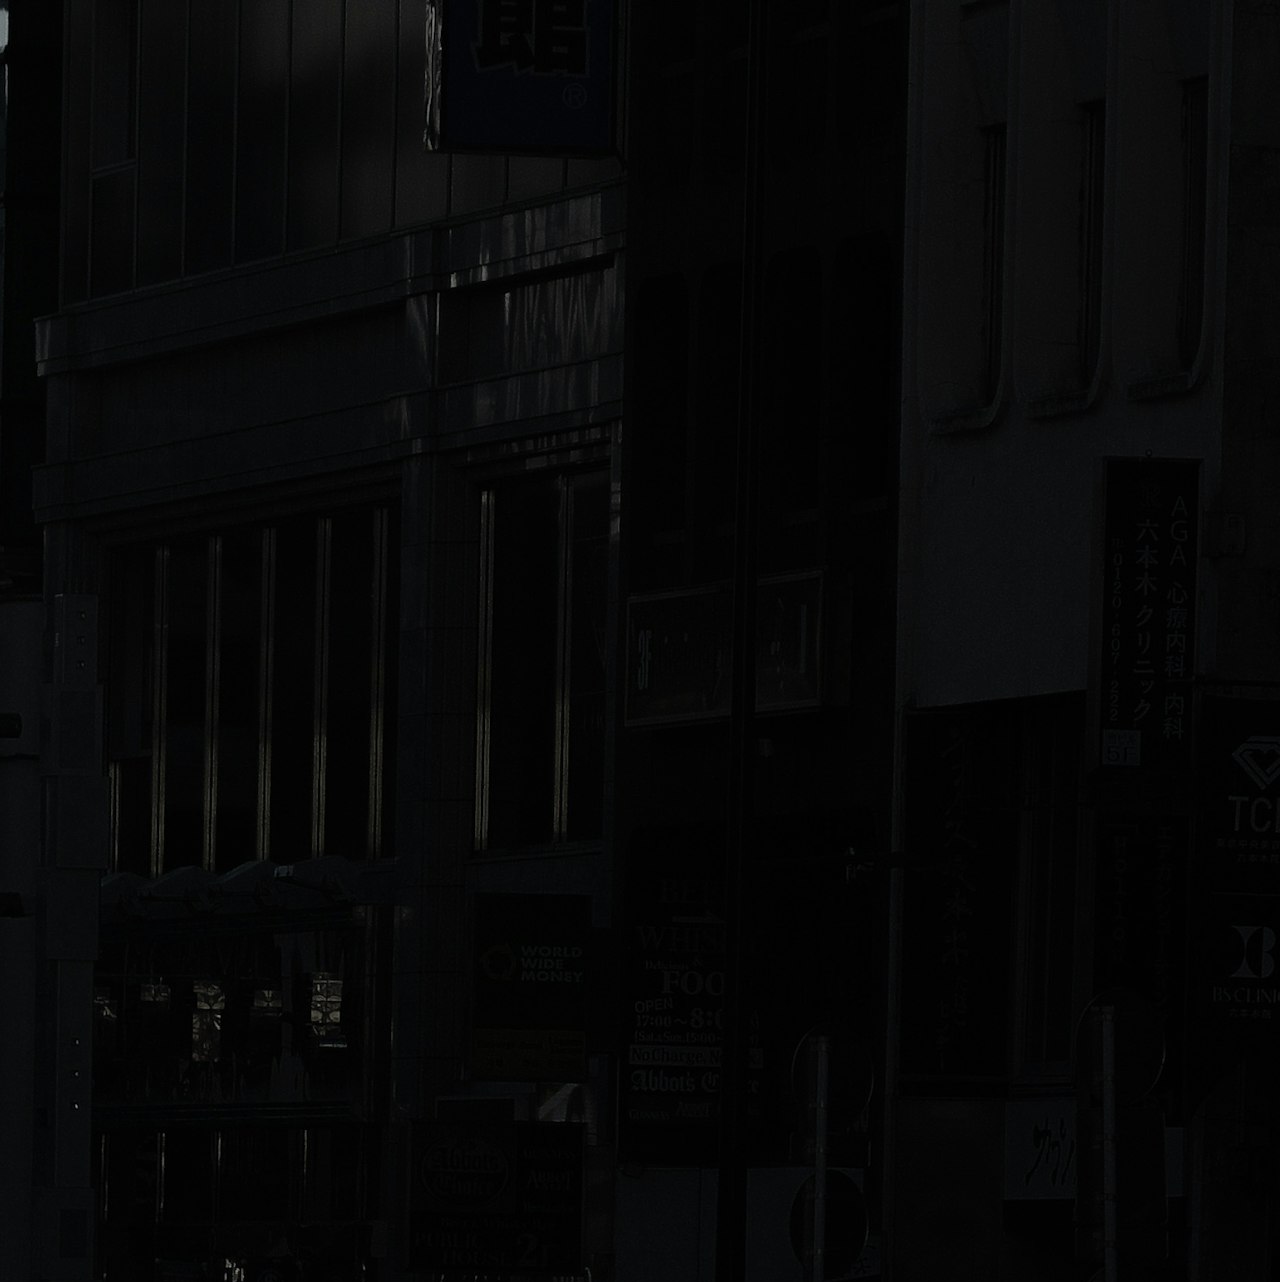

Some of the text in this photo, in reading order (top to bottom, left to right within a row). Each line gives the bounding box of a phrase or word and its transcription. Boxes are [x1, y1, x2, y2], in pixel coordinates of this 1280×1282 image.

[1169, 495, 1189, 568] AGA
[1133, 518, 1160, 726] 六本木クリニック
[1228, 795, 1280, 833] TC
[520, 945, 583, 958] WORLD
[520, 958, 564, 970] WIDE
[634, 998, 674, 1014] OPEN
